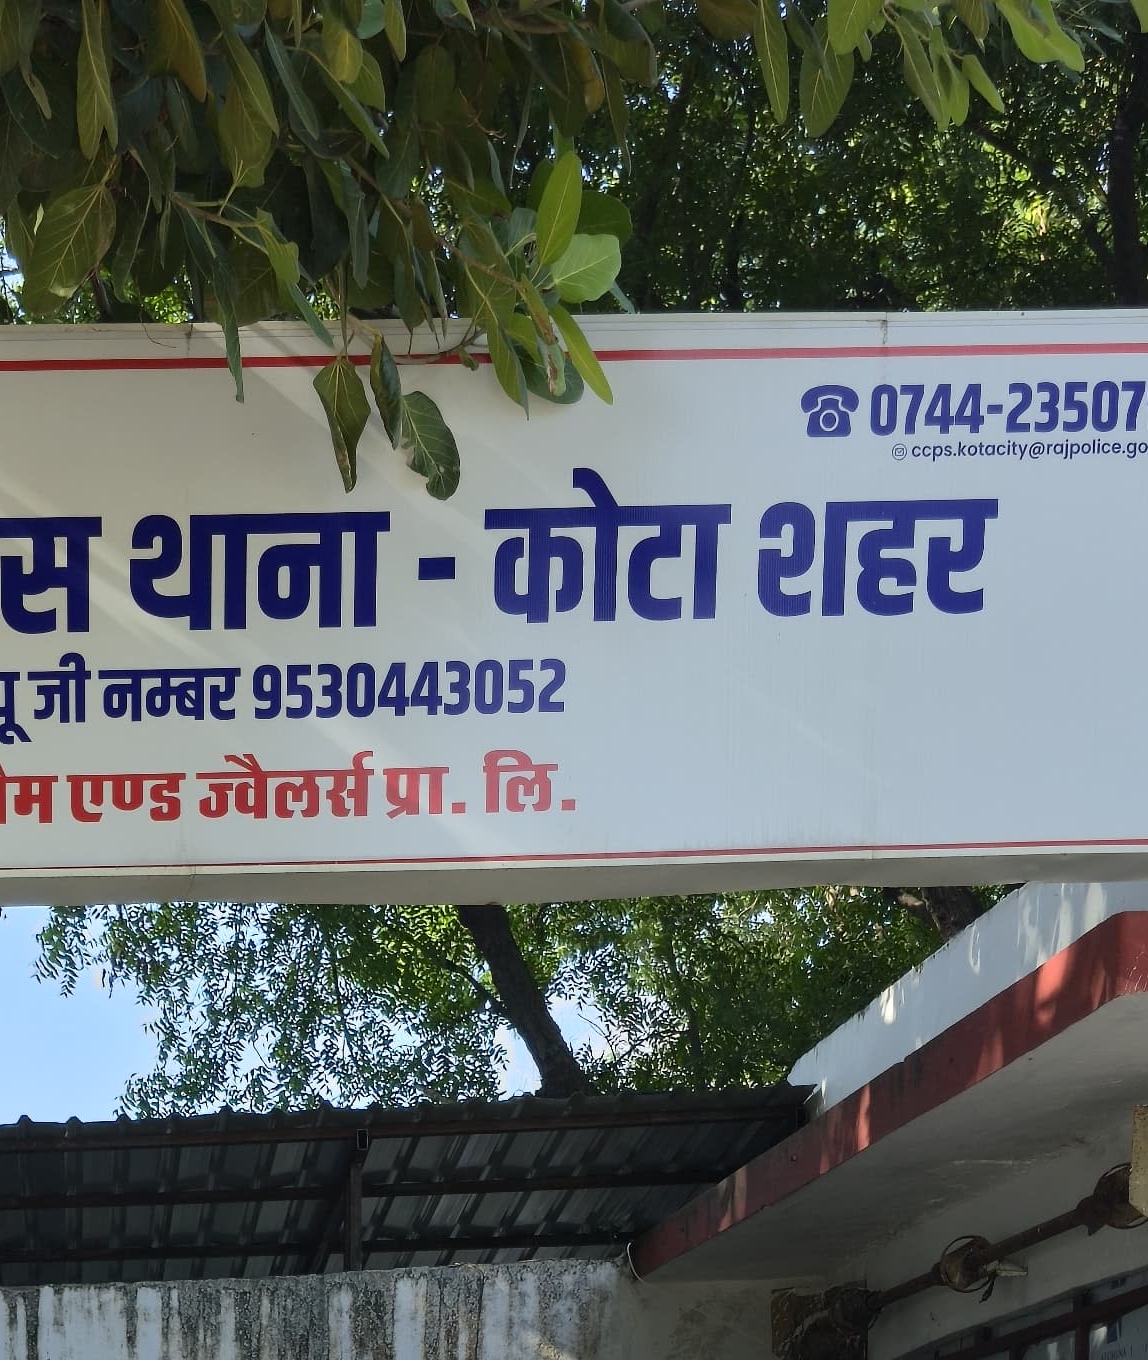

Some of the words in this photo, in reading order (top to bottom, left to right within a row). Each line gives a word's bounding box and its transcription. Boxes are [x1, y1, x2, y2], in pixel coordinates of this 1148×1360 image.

[130, 511, 391, 632] थाना
[484, 467, 732, 624] कोटा
[758, 498, 999, 618] शहर
[27, 652, 92, 724] जी
[98, 667, 242, 723] नम्बर
[253, 658, 566, 720] 9530443052
[66, 772, 186, 824] एण्ड
[195, 750, 375, 820] ज्वैलर्स
[382, 766, 466, 820] प्रा.
[482, 749, 576, 813] लि.
